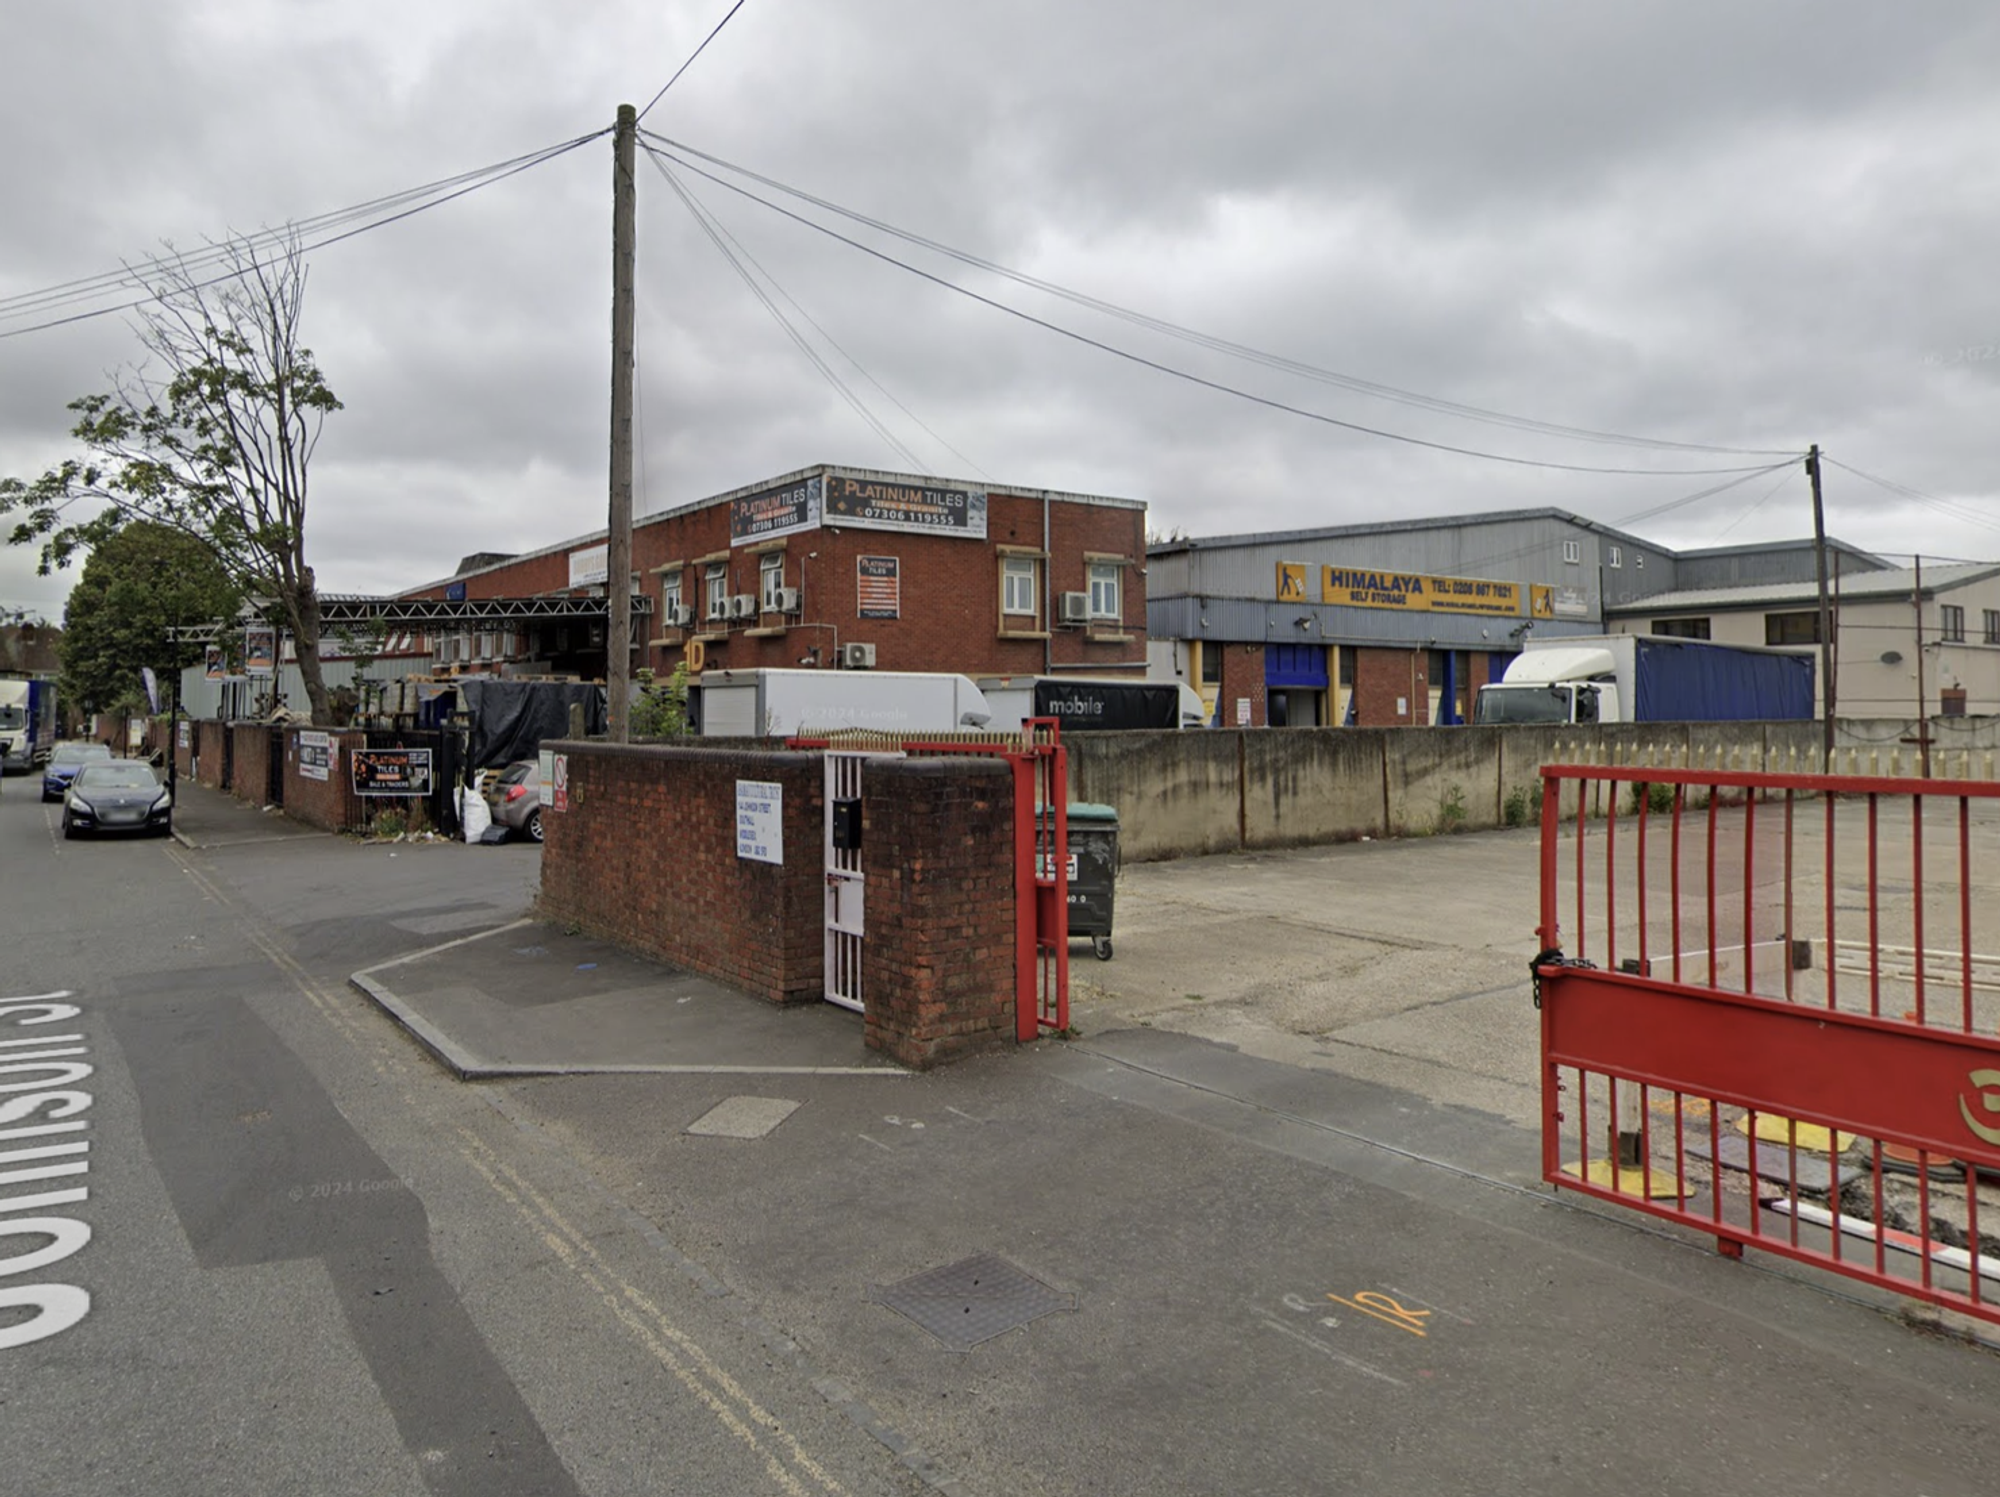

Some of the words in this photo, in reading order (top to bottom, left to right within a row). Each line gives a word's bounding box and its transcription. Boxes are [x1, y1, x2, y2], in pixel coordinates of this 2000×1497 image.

[740, 494, 780, 518] PLATINUM
[782, 487, 806, 506] TILES
[845, 480, 922, 503] PLATINUM
[925, 491, 964, 508] TILES
[752, 520, 773, 534] 07306
[774, 512, 798, 529] 119555
[865, 507, 905, 521] 07306
[910, 512, 955, 526] 119555
[1331, 570, 1423, 595] HIMALAYA
[1432, 580, 1451, 593] TEL:
[1350, 590, 1369, 603] SELF
[1371, 592, 1407, 606] STORAGE
[684, 639, 704, 671] 1D
[1050, 695, 1102, 715] mobile
